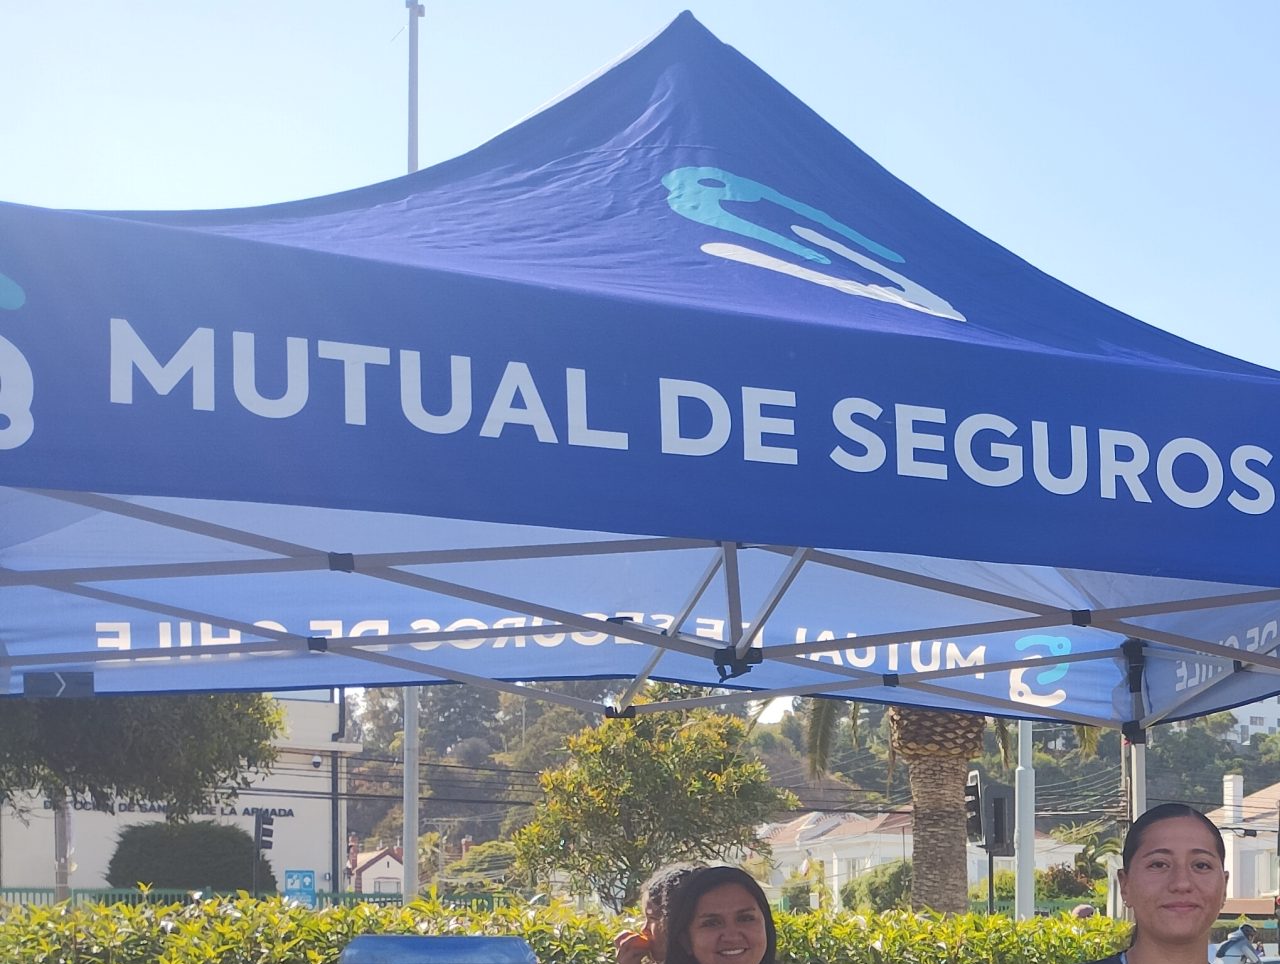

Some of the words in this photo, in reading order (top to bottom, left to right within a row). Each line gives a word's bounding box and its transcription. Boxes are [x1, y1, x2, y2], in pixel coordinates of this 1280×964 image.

[108, 317, 629, 451] MUTUAL
[659, 377, 798, 466] DE
[830, 397, 1276, 516] SEGUROS
[221, 807, 237, 816] LA
